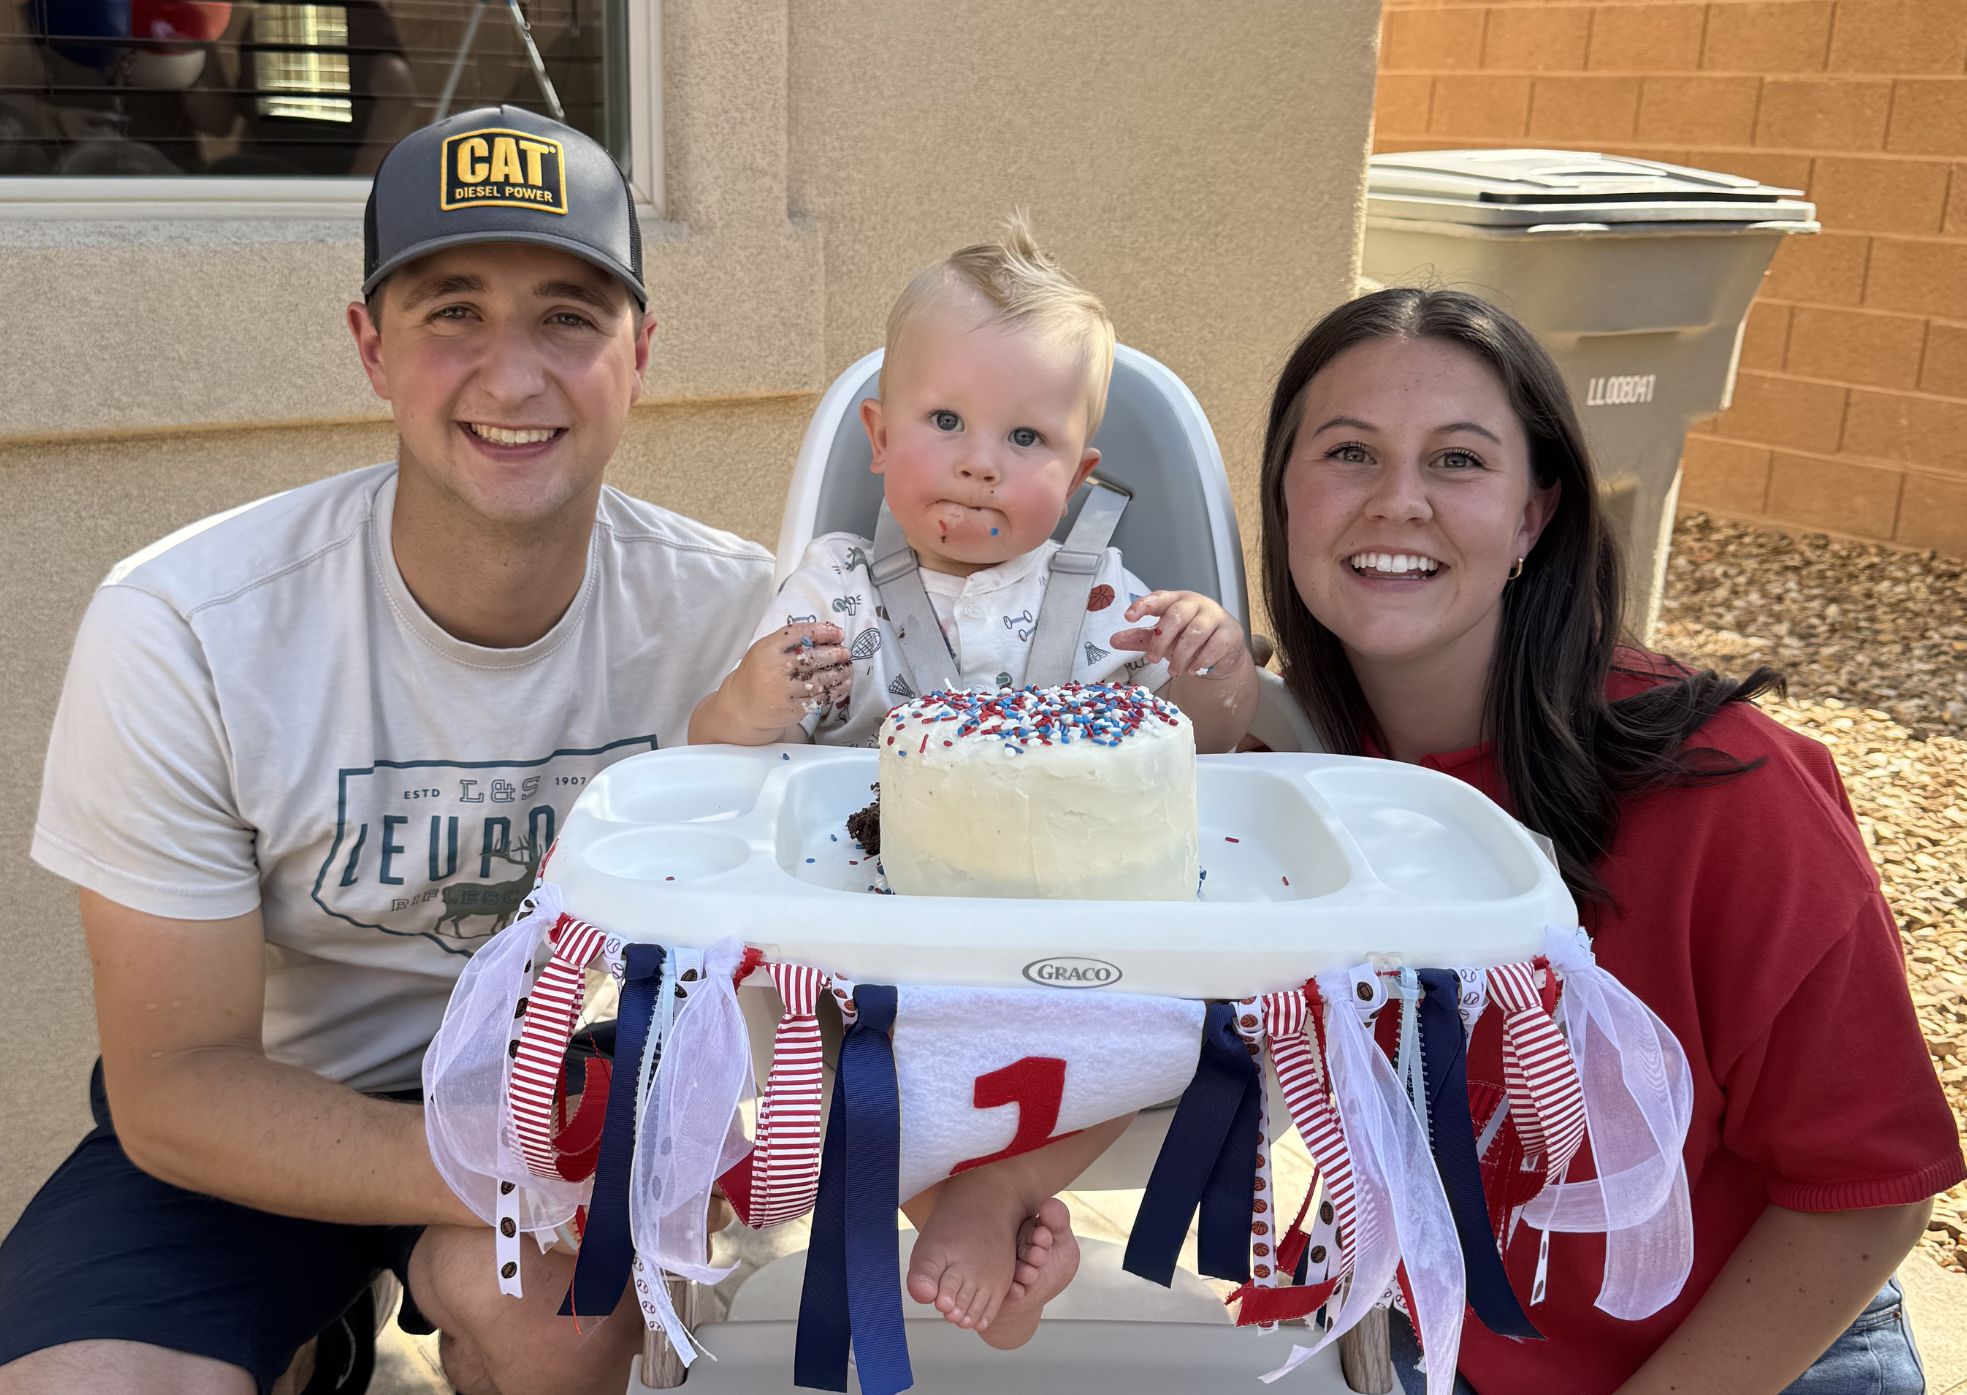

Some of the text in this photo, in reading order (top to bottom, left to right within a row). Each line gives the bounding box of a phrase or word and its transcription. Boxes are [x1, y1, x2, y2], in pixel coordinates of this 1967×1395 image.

[457, 137, 550, 187] CAT
[455, 186, 553, 202] DIESEL POWER
[404, 789, 440, 799] ESTD
[555, 776, 587, 786] 1907
[949, 1056, 1085, 1176] 1
